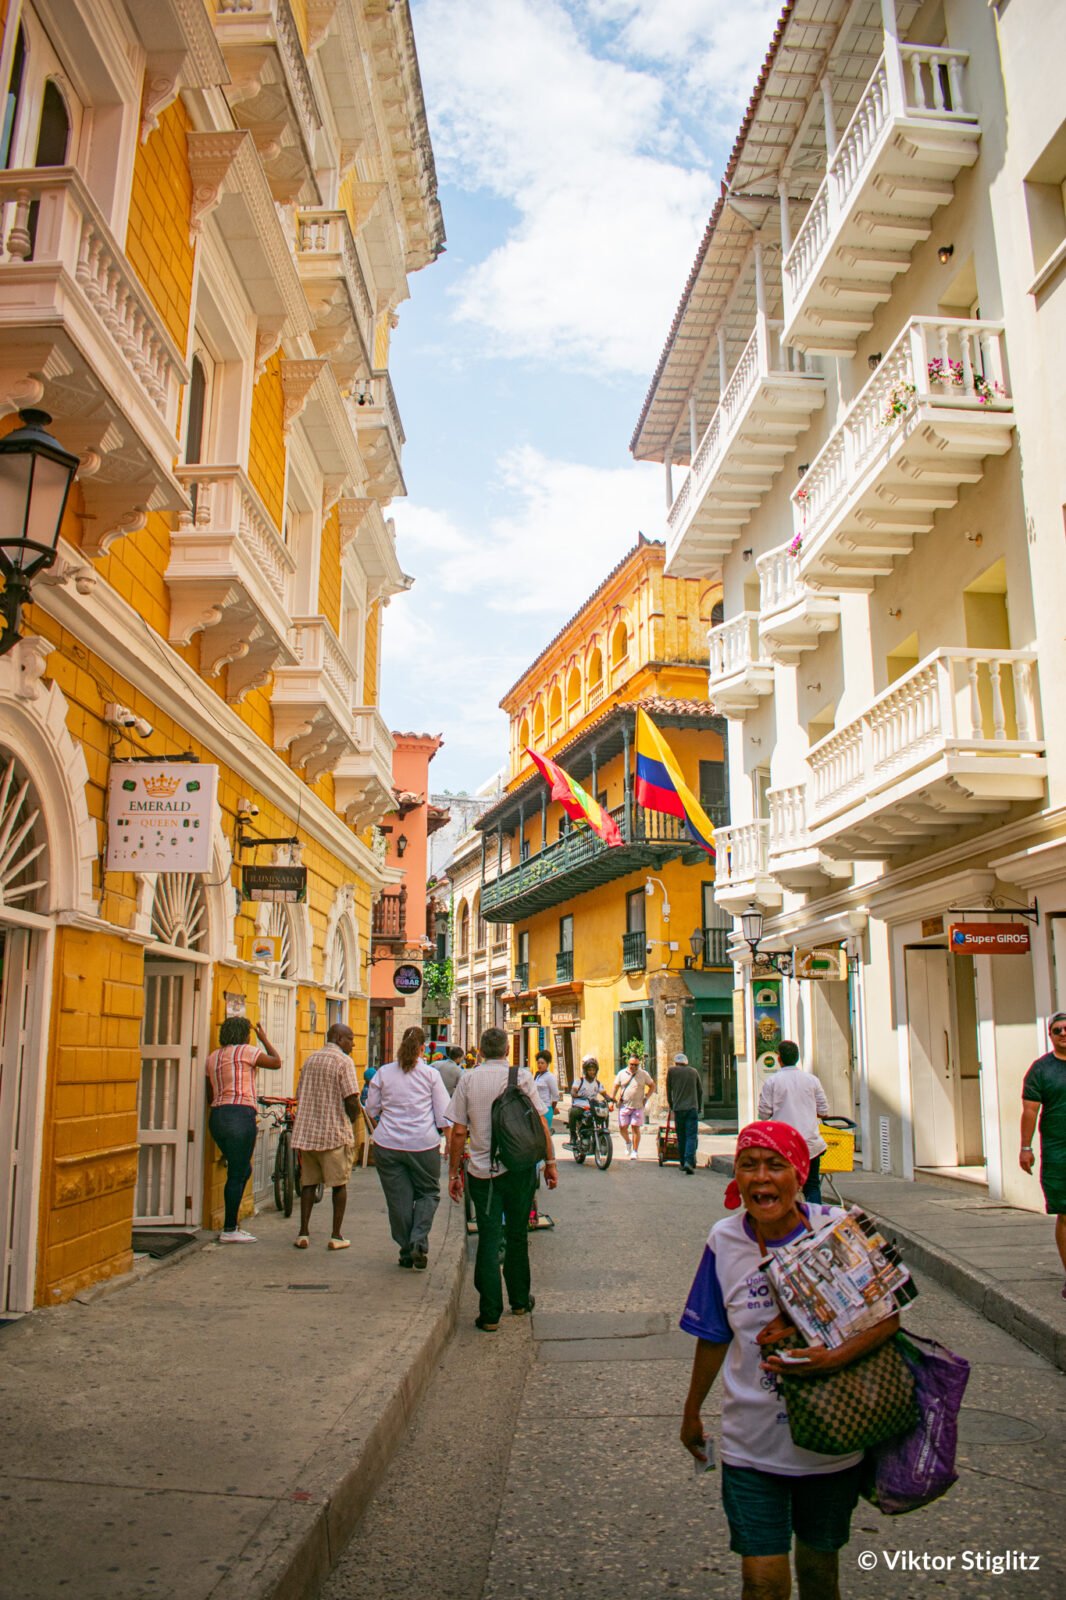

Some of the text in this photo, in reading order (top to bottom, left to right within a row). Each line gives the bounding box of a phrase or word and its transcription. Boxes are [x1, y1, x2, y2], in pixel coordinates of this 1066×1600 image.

[128, 801, 192, 812] EMERALD
[140, 818, 179, 829] QUEEN
[965, 933, 1029, 945] Super GIROS
[747, 1297, 774, 1309] en el
